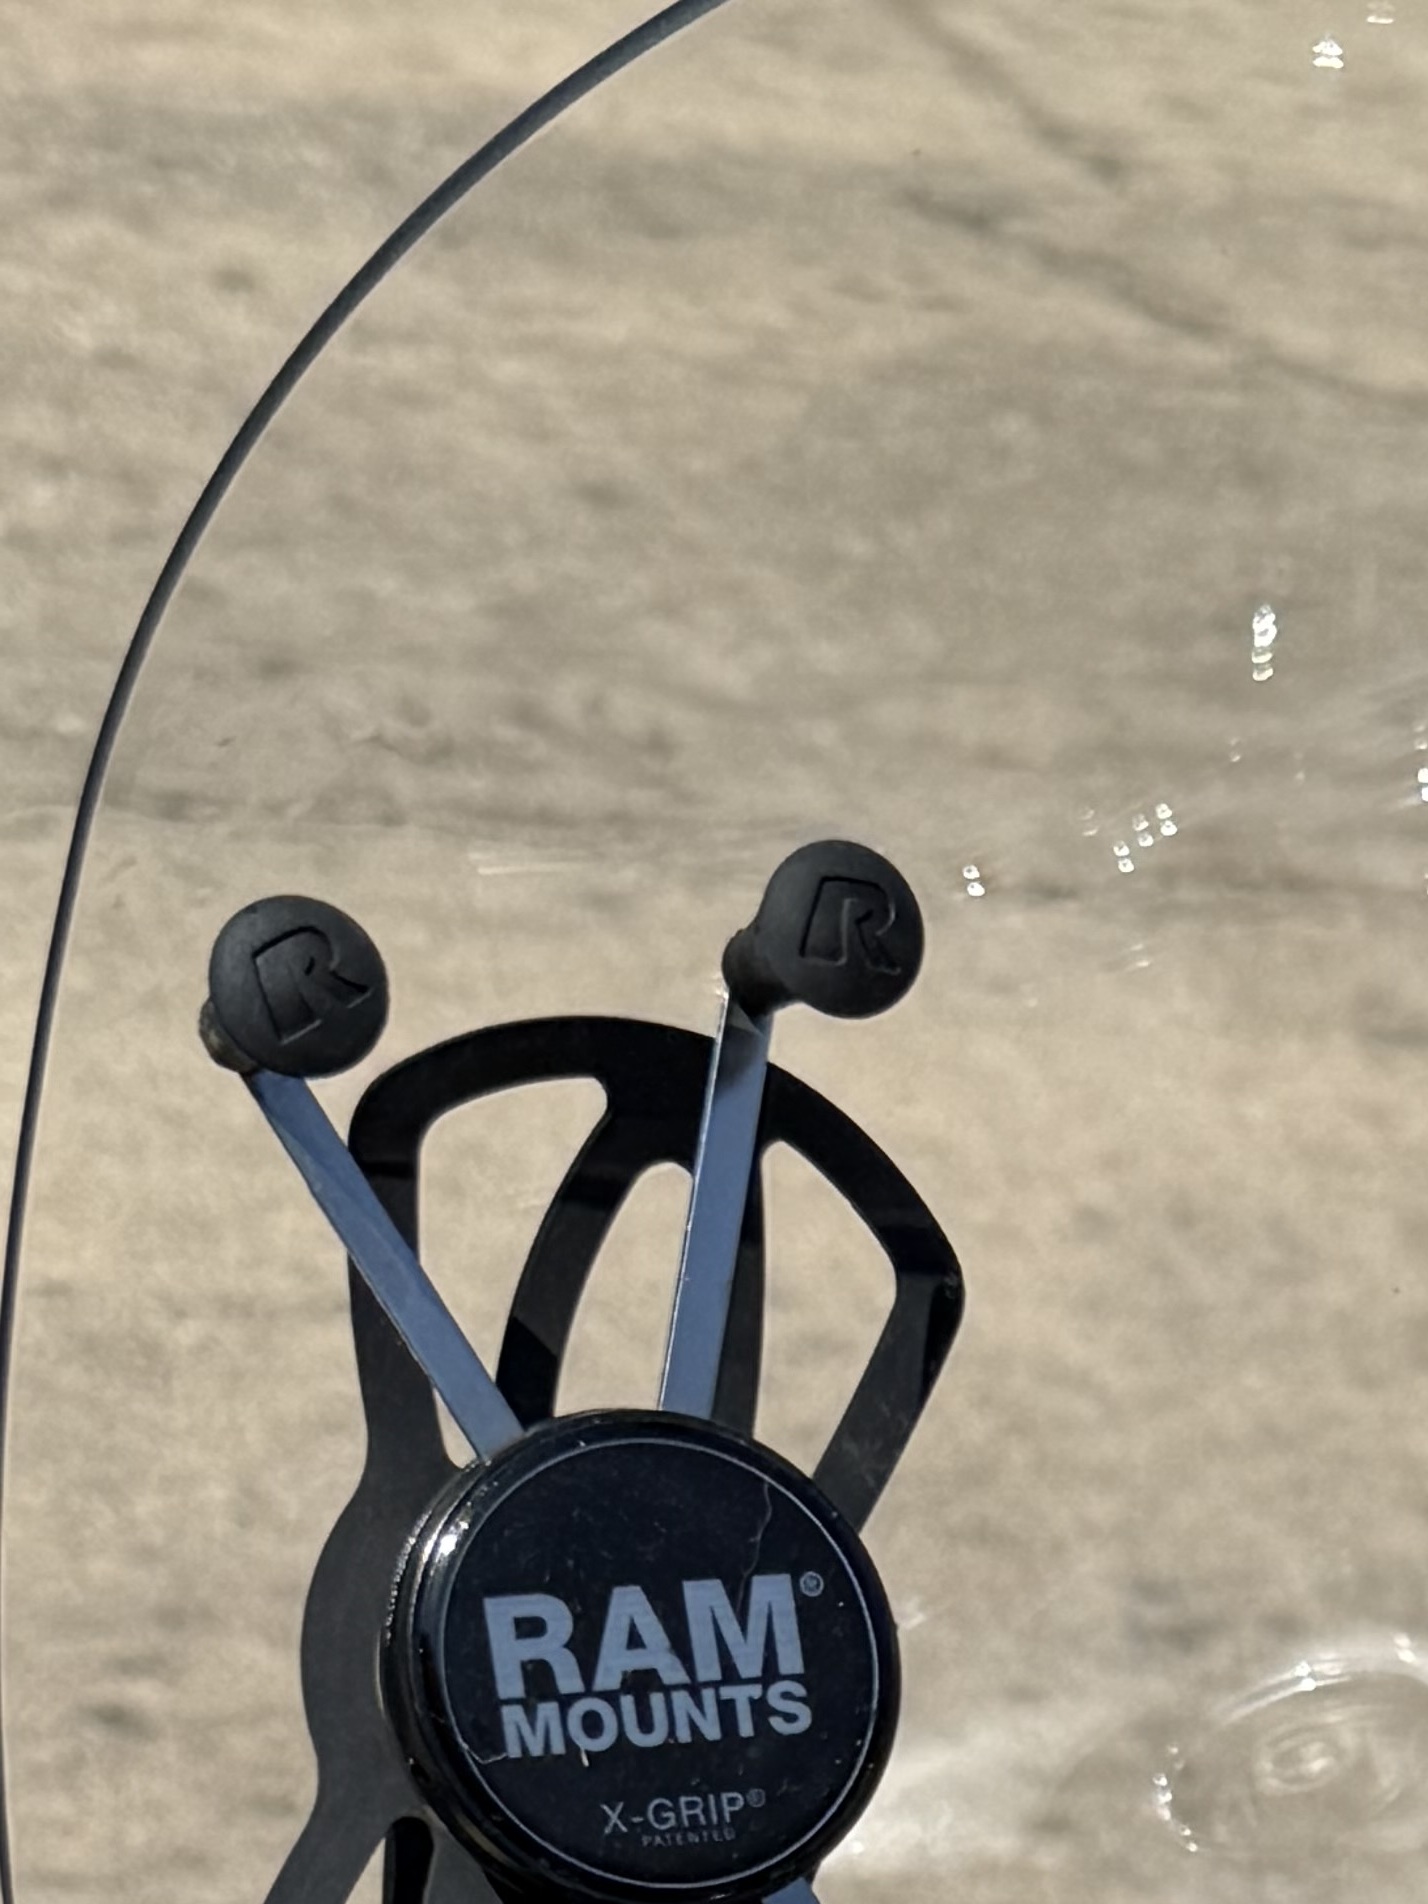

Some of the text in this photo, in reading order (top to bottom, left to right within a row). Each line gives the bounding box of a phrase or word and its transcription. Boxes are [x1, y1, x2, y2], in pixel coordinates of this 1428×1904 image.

[800, 876, 900, 975] R
[252, 925, 372, 1046] R
[499, 1680, 812, 1758] MOUNTS
[641, 1826, 737, 1848] PATENTED
